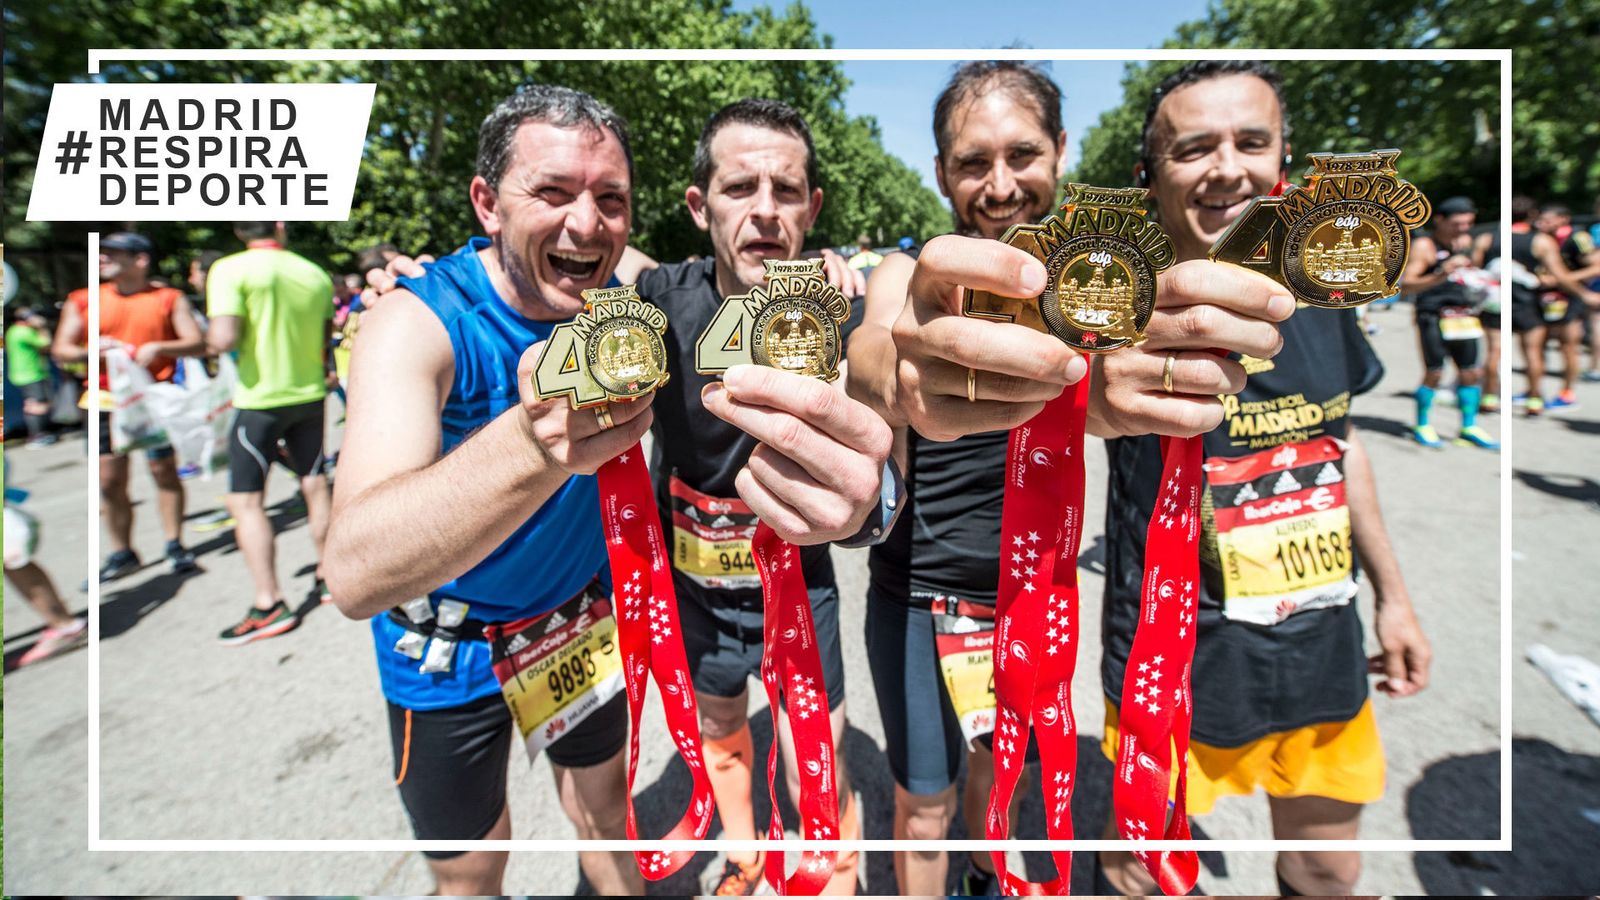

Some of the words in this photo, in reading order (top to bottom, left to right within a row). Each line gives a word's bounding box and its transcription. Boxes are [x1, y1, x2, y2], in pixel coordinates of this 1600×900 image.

[1325, 160, 1385, 172] 1978-2017
[1081, 192, 1135, 206] 1978-2017
[1278, 175, 1429, 226] MADRID
[1335, 214, 1360, 229] edp
[1036, 208, 1175, 269] MADRID
[773, 265, 813, 274] 1978-2017
[1088, 251, 1112, 267] edp
[1320, 271, 1358, 282] 42K
[594, 289, 630, 300] 1978-2017
[743, 277, 849, 319] MADRID
[572, 300, 667, 342] MADRID
[785, 309, 803, 322] edp
[1075, 309, 1110, 325] 42K
[1228, 403, 1324, 437] MADRID
[1019, 427, 1030, 453] Rock
[1017, 463, 1026, 488] Roll
[1064, 505, 1072, 527] Roll
[613, 525, 622, 544] Roll
[1061, 536, 1071, 560] Rock
[1276, 531, 1346, 582] 10168
[1151, 565, 1159, 593] Rock
[1149, 602, 1157, 624] Roll
[1003, 615, 1012, 641] Rock
[527, 655, 556, 680] OSCAR
[999, 650, 1007, 672] Roll
[548, 647, 596, 702] 9893
[1061, 708, 1070, 736] Rock
[1128, 735, 1137, 756] Rock
[1125, 764, 1135, 785] Roll
